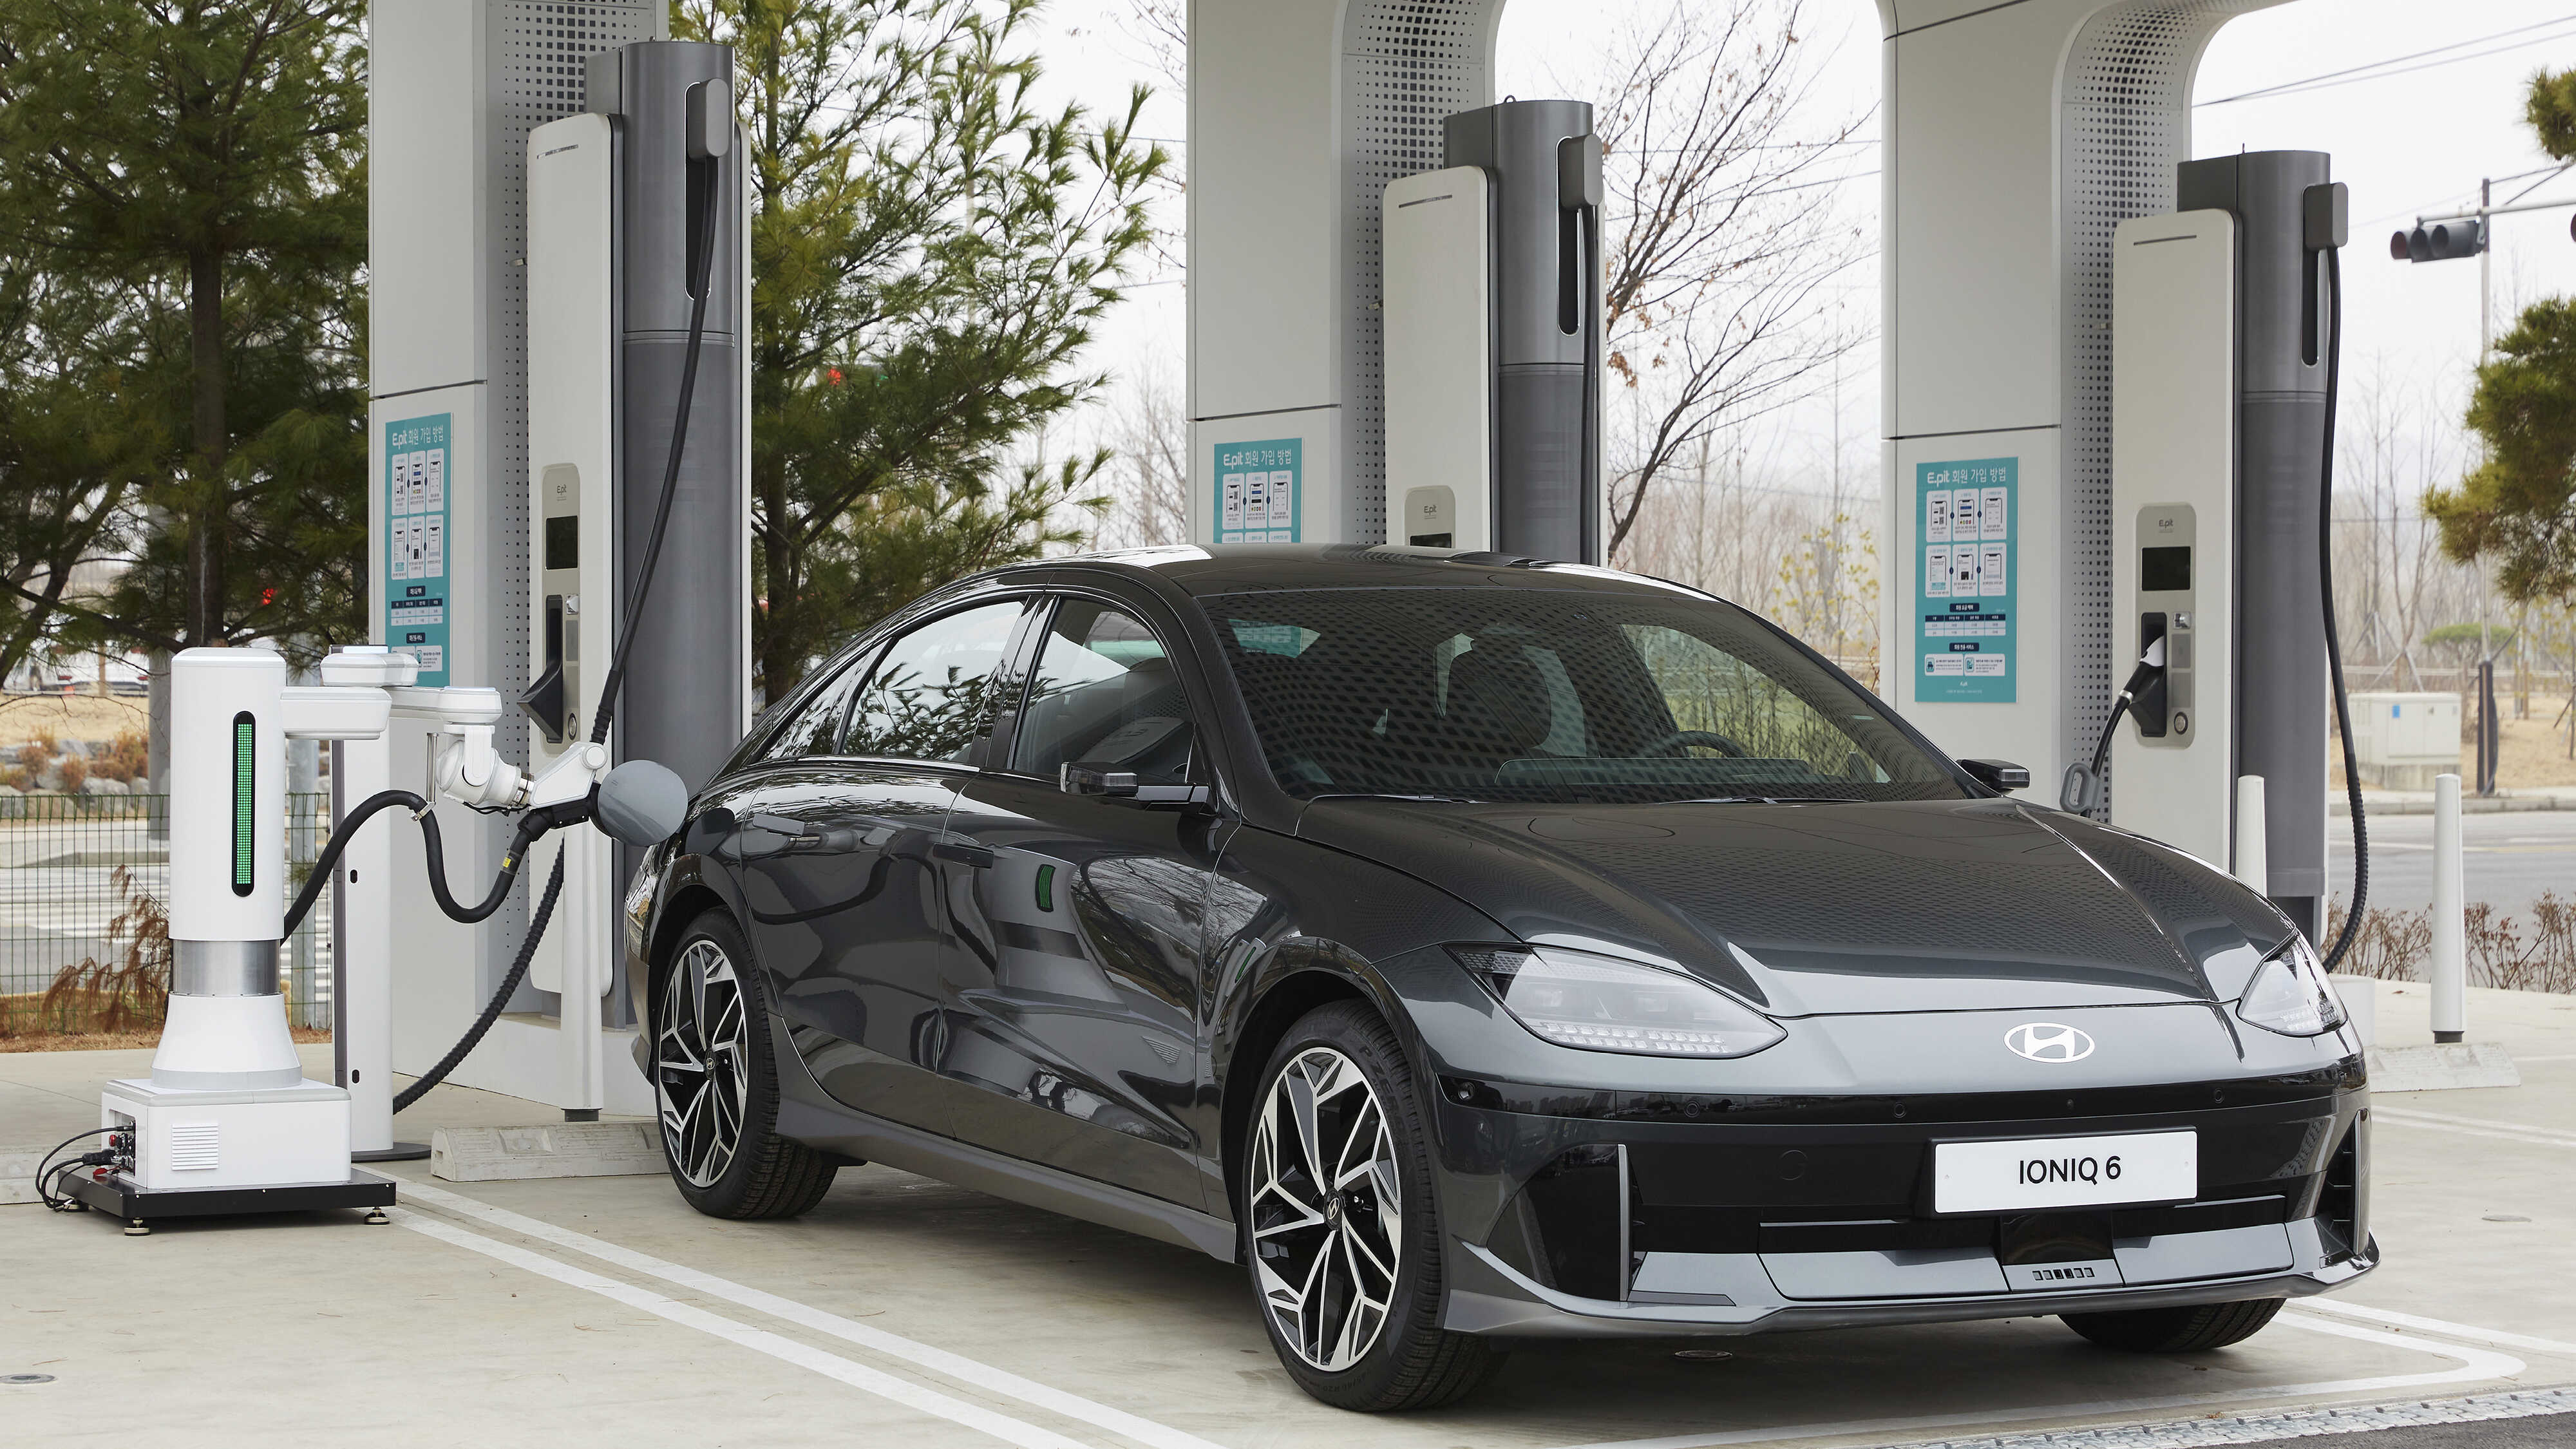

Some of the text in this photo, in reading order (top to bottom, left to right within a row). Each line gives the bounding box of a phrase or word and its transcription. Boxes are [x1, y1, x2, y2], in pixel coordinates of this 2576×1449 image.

[408, 428, 419, 445] 회원
[421, 426, 431, 444] 가입
[432, 424, 444, 443] 방법
[1245, 450, 1259, 466] 회원
[1261, 450, 1275, 465] 가입
[1277, 448, 1292, 465] 방법
[1952, 469, 1968, 484] 회원
[1971, 468, 1987, 482] 가입
[1989, 466, 2007, 482] 방법
[2019, 1155, 2121, 1186] IONIQ 6
